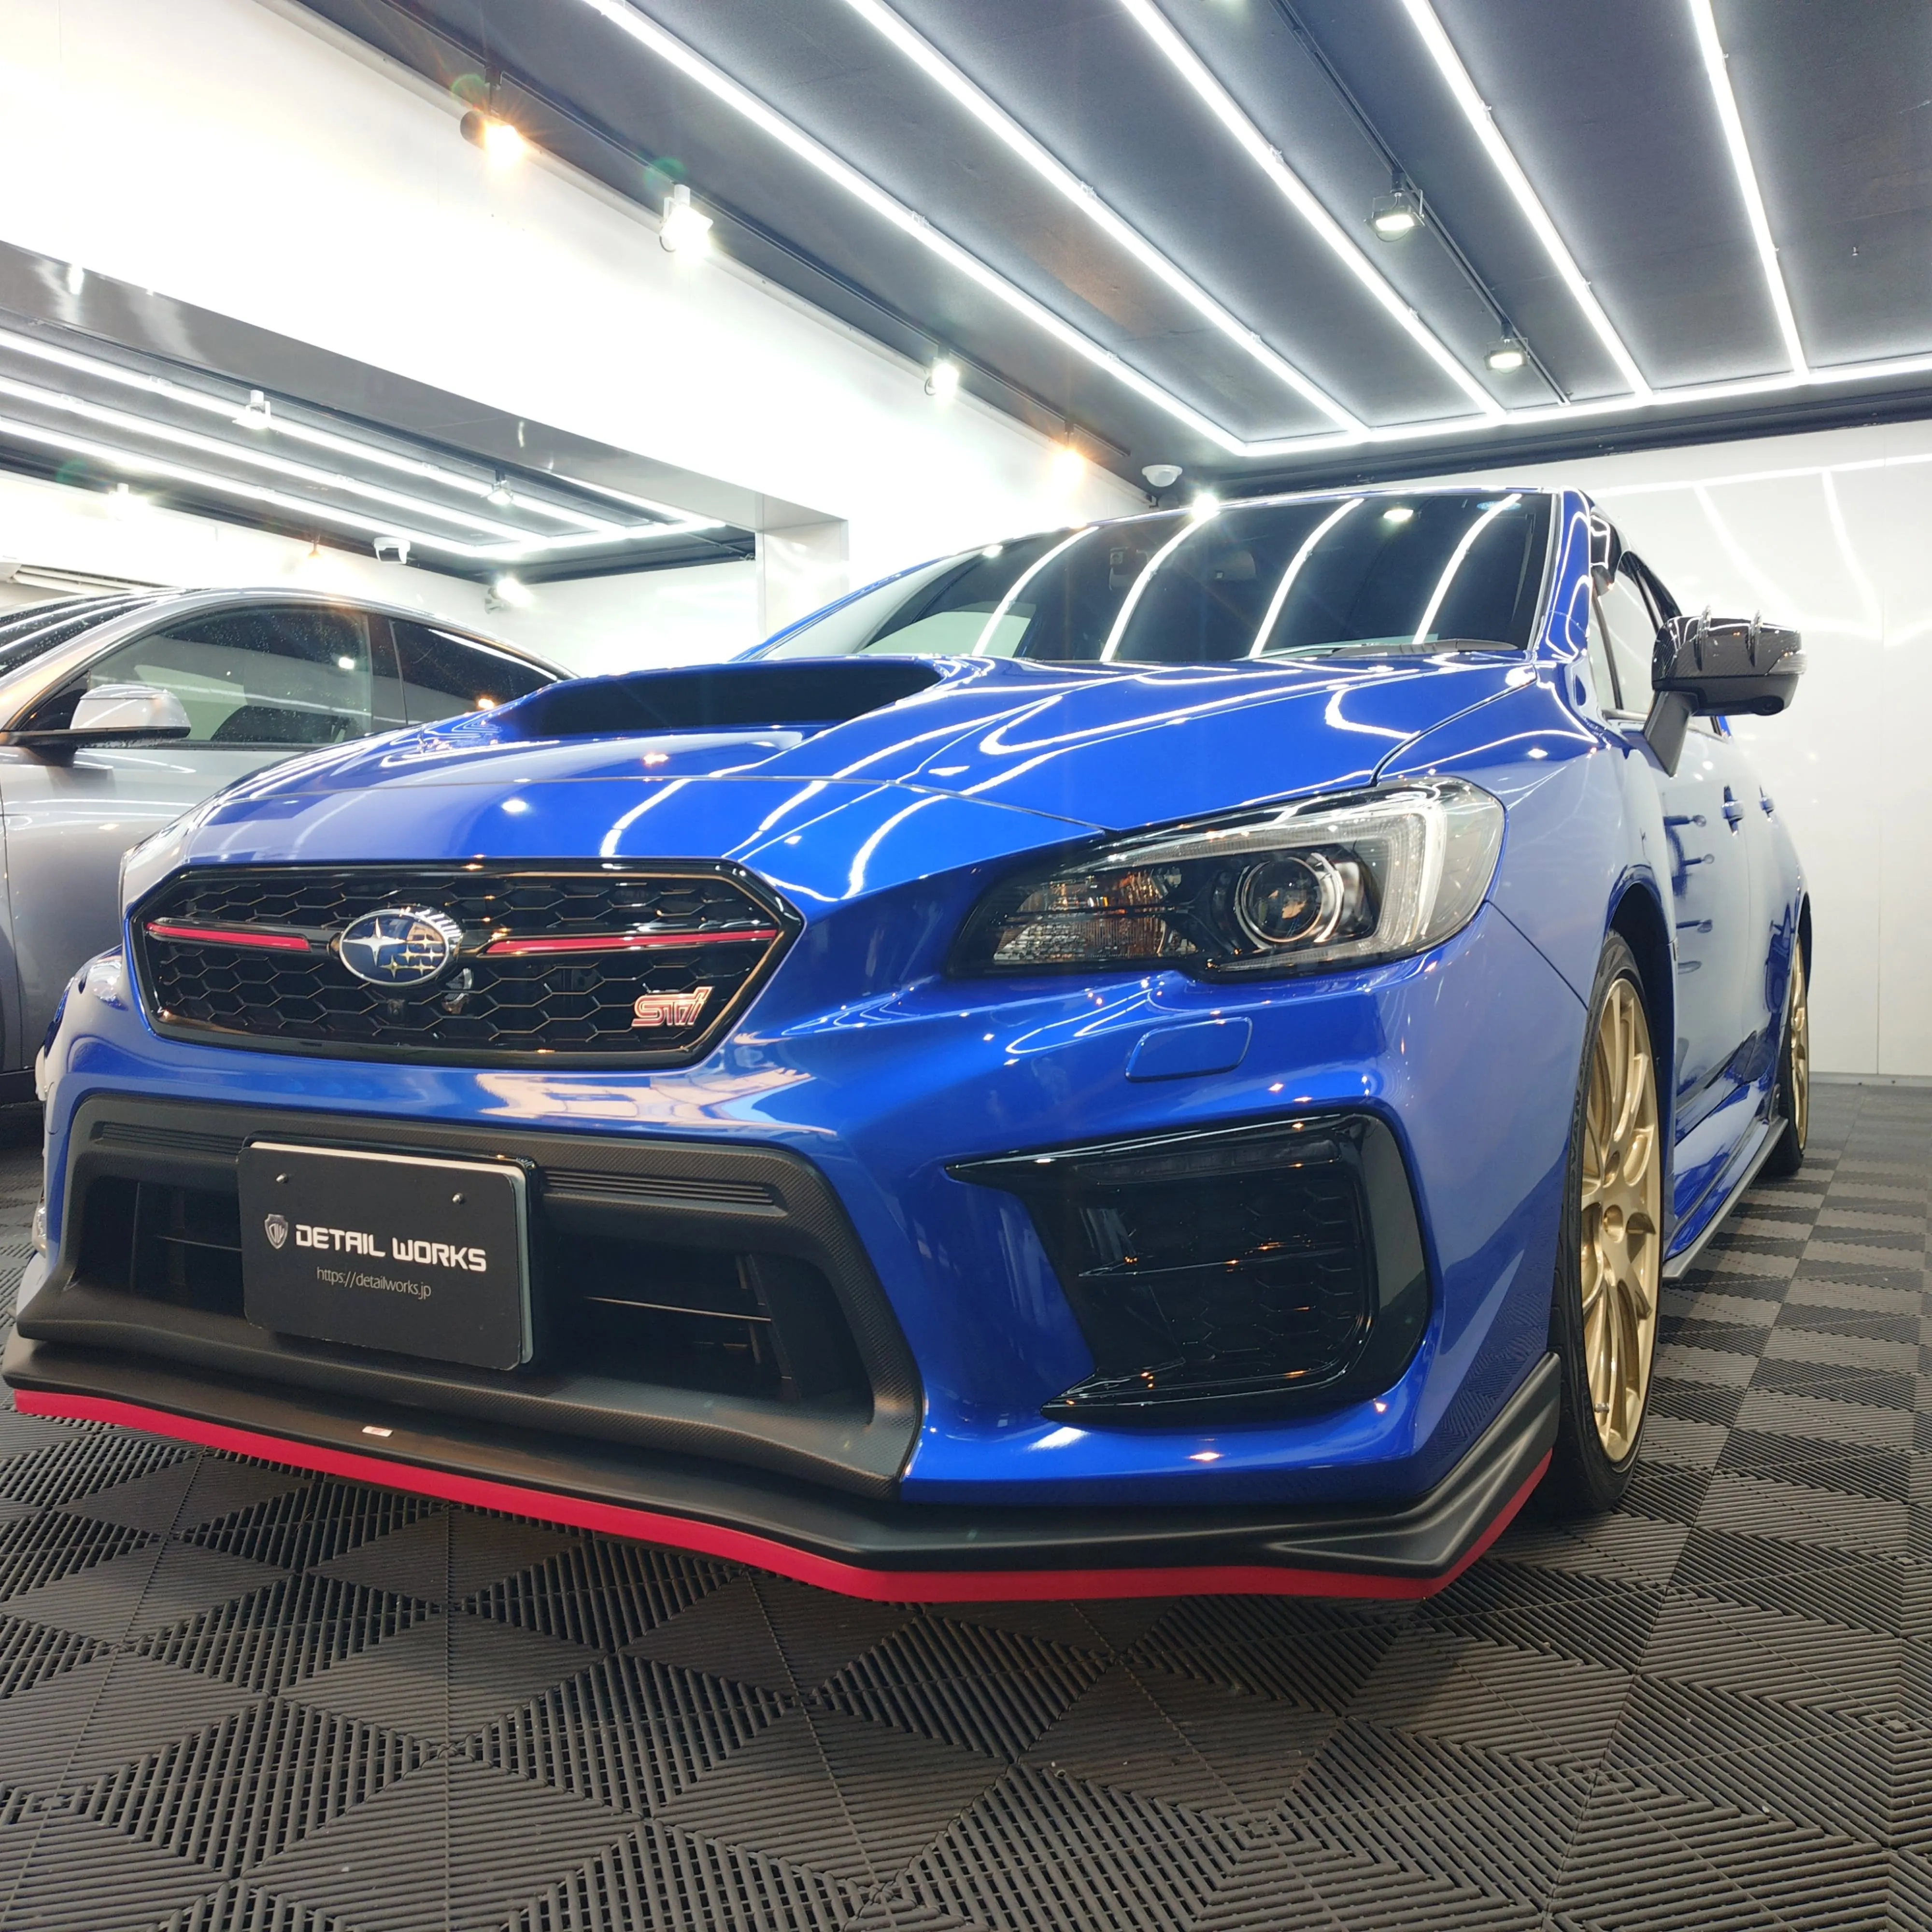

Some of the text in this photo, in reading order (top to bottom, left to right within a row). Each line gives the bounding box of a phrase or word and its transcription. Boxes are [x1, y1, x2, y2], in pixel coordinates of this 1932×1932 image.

[295, 1224, 487, 1272] DETAIL WORKS
[316, 1266, 432, 1300] https://detailworks.jp
